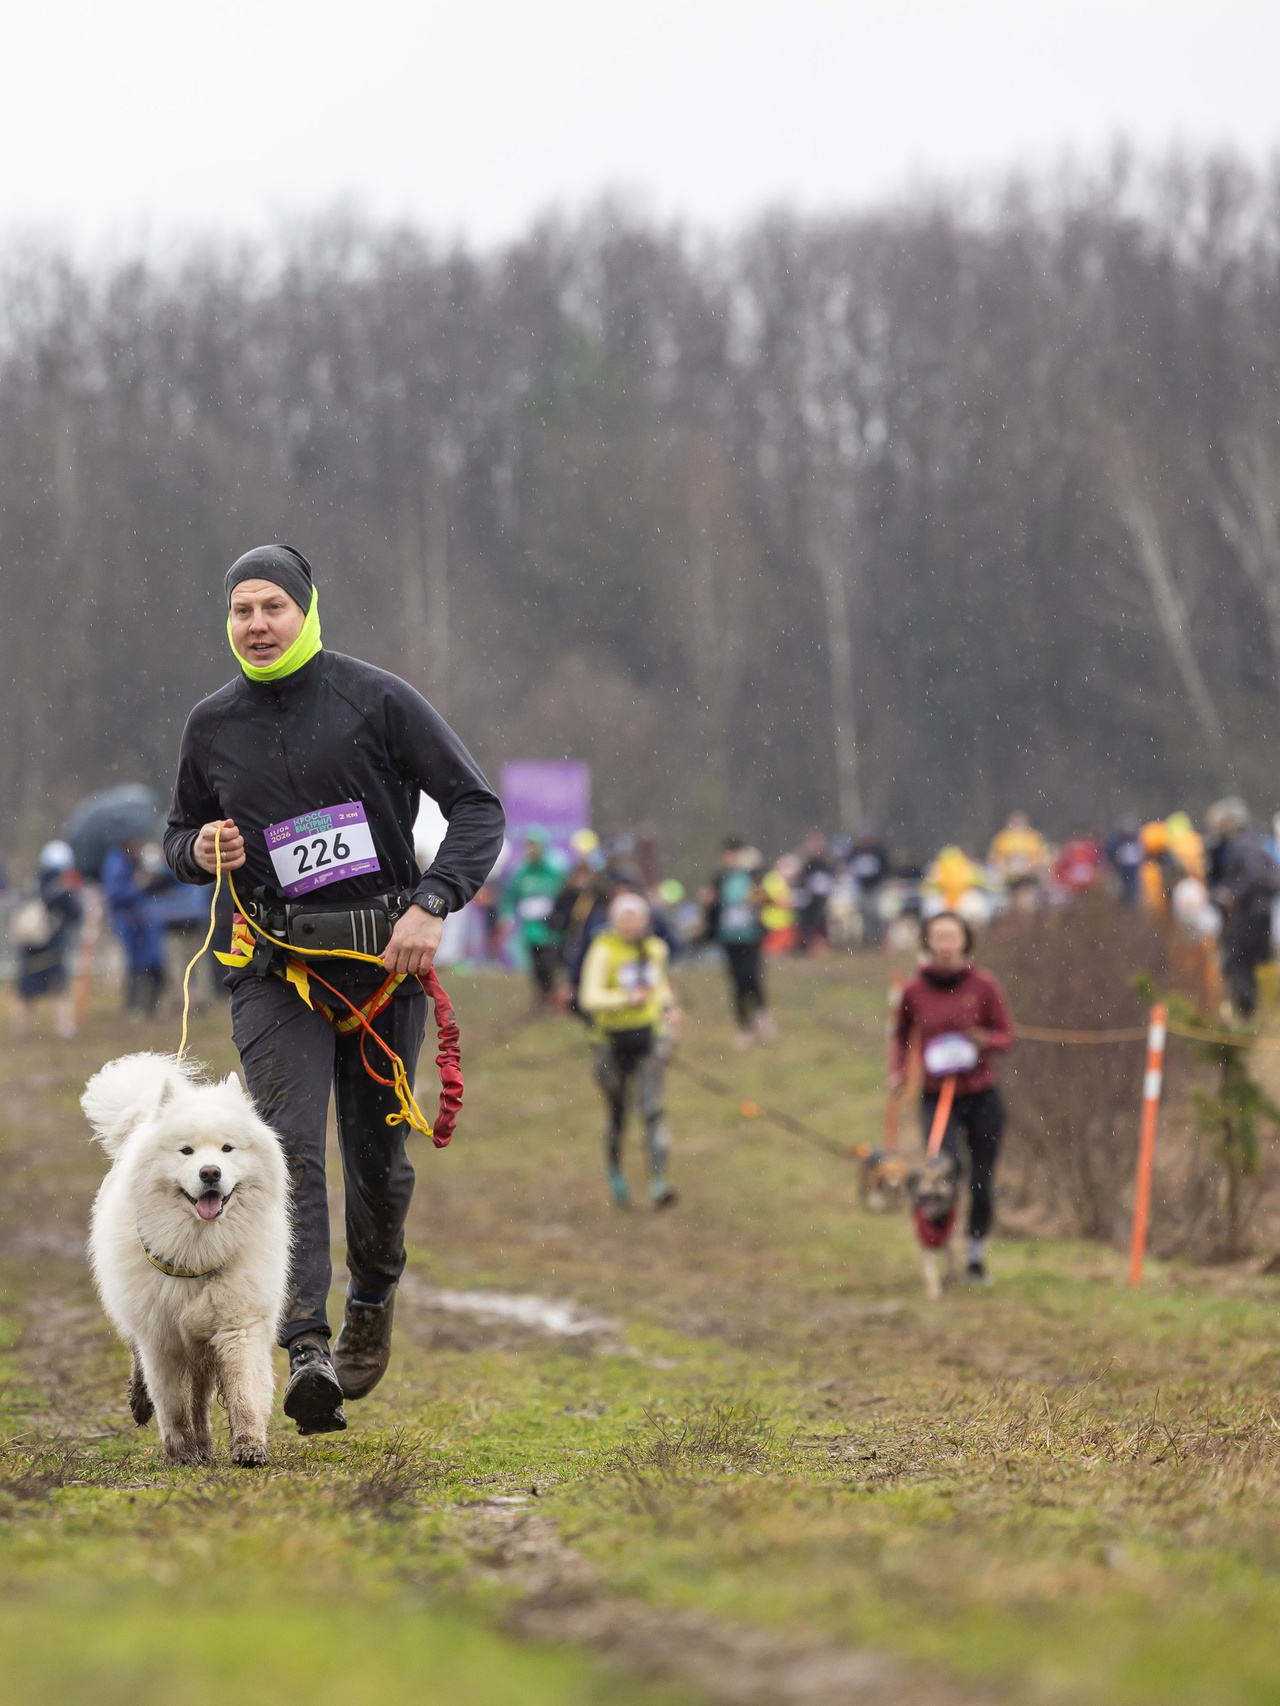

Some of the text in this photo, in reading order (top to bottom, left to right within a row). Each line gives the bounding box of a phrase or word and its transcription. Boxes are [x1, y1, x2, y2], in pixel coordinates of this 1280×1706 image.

[293, 812, 322, 826] КРОСС
[295, 814, 332, 833] БЫСТРЫЙ
[269, 826, 289, 837] 11/04
[271, 832, 291, 843] 2026
[293, 832, 350, 874] 226
